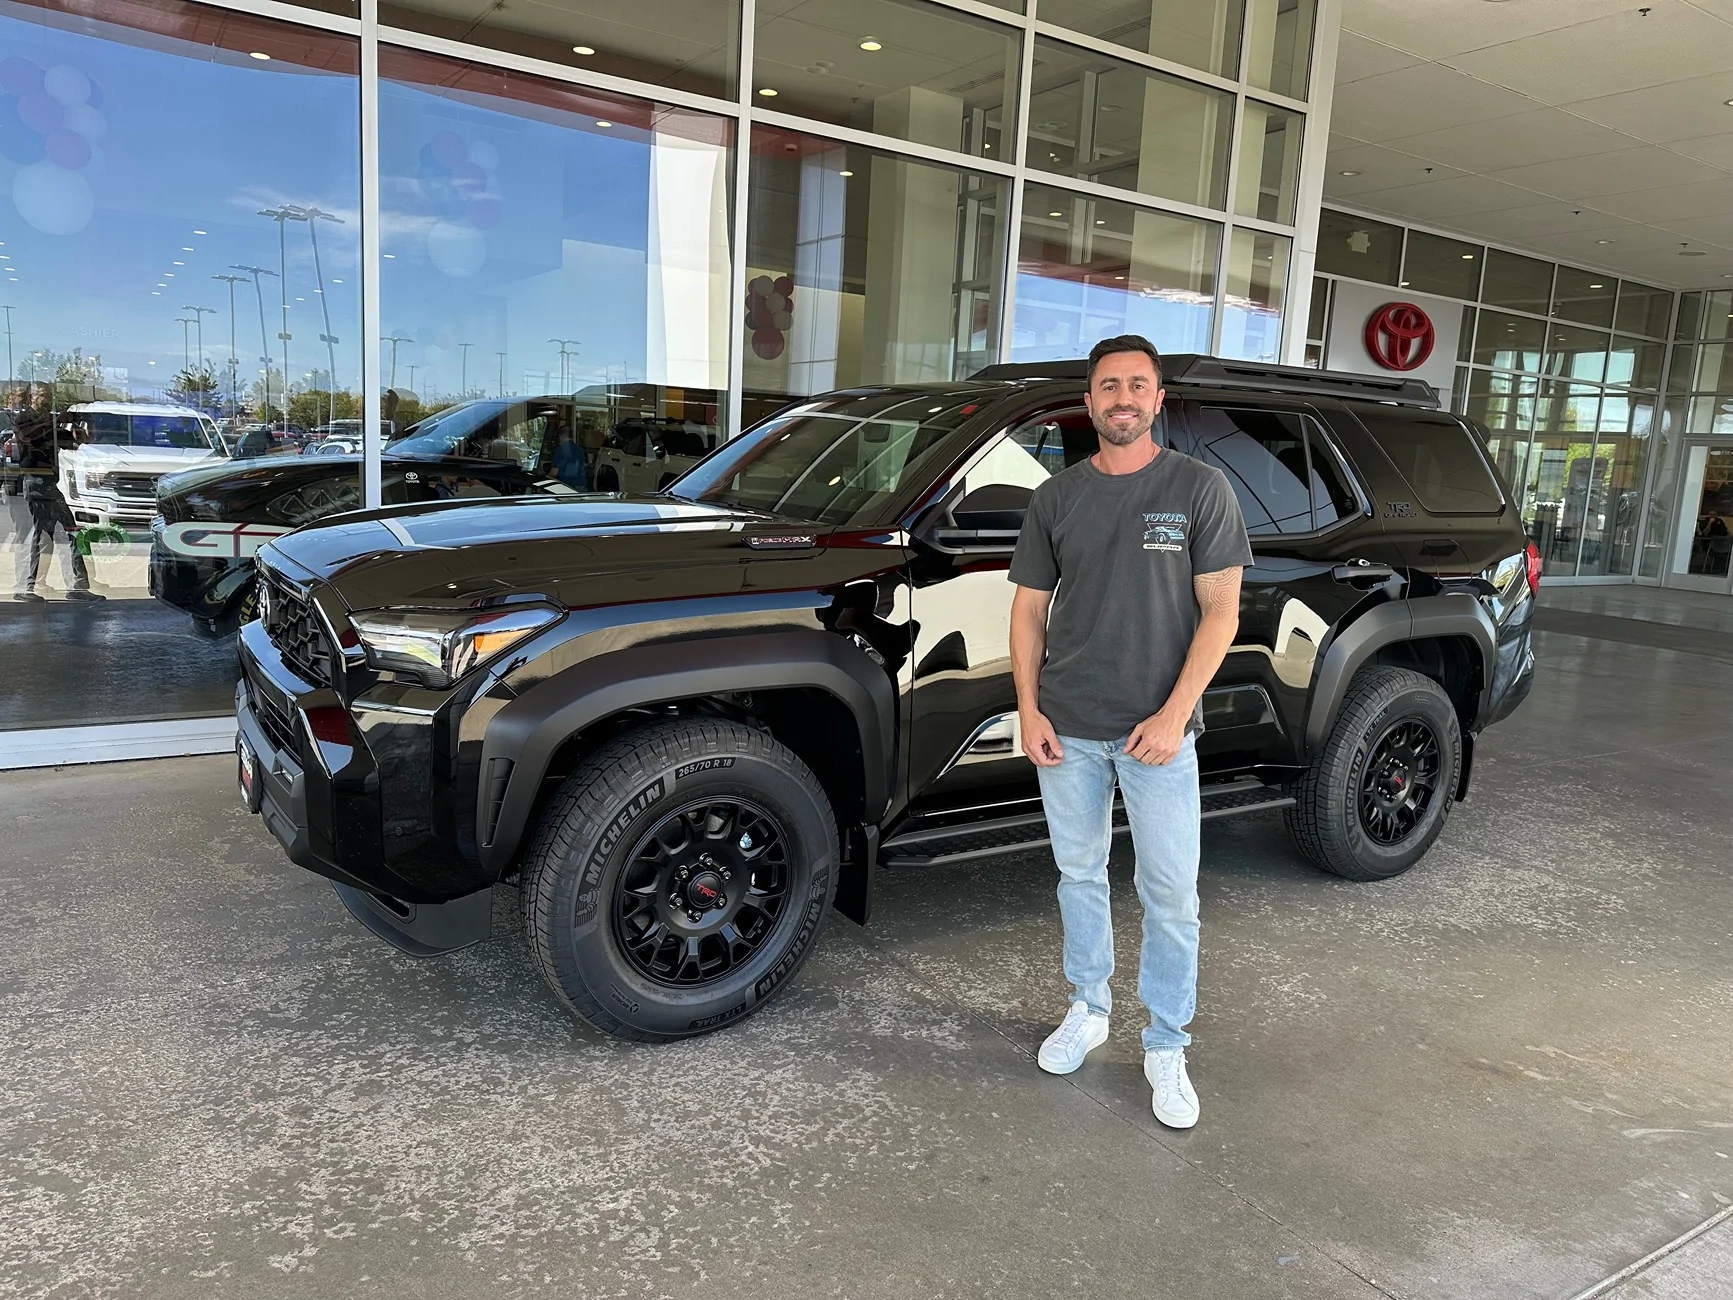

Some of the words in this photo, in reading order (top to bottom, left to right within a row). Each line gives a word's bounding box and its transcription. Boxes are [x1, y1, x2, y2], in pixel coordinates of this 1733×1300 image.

[1387, 501, 1411, 513] TRD
[1142, 512, 1188, 524] TOYOTA
[678, 760, 711, 778] 265/70
[713, 759, 720, 768] R
[723, 758, 733, 767] 18
[1445, 742, 1461, 812] MICHELIN
[1346, 751, 1363, 827] MICHELIN
[585, 783, 661, 886] MICHELIN
[697, 884, 717, 899] TRD
[759, 902, 821, 996] MICHELIN
[724, 1005, 742, 1020] LTX
[696, 1015, 720, 1029] TRAIL
